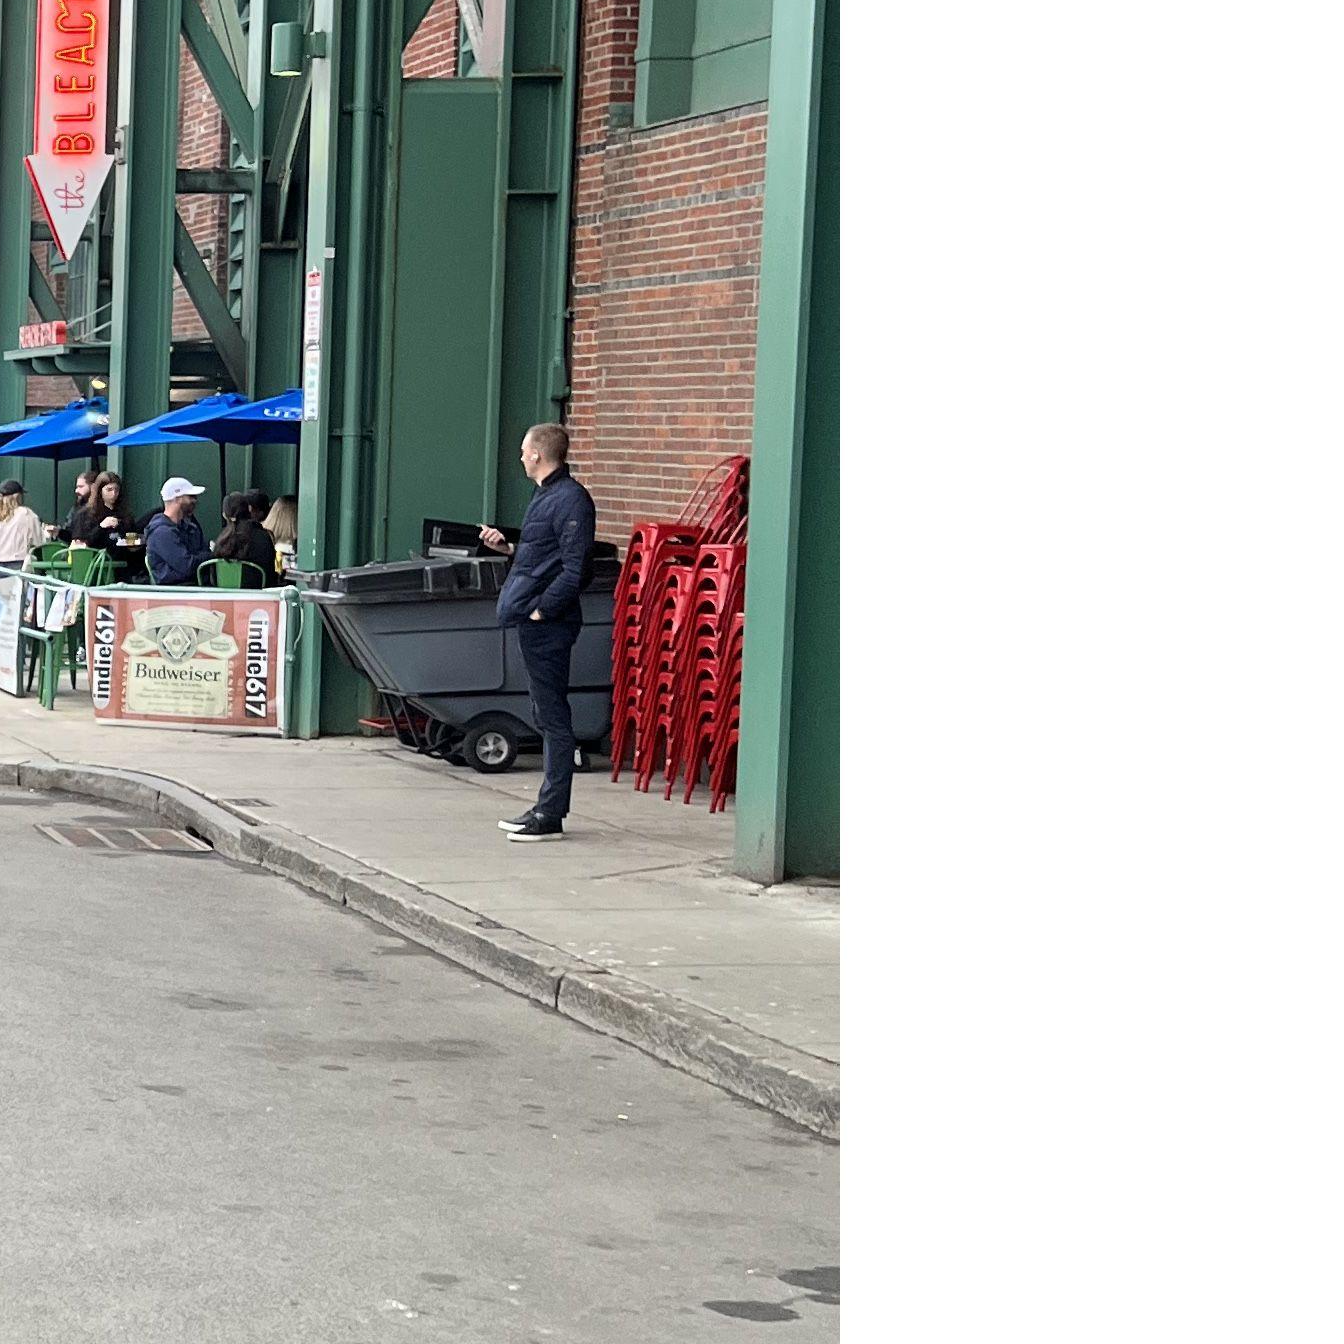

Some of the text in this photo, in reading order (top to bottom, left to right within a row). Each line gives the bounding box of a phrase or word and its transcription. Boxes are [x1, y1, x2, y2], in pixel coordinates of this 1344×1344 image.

[52, 168, 86, 215] the
[92, 605, 115, 700] indie617
[135, 662, 221, 683] Budweiser
[246, 619, 268, 718] indie617
